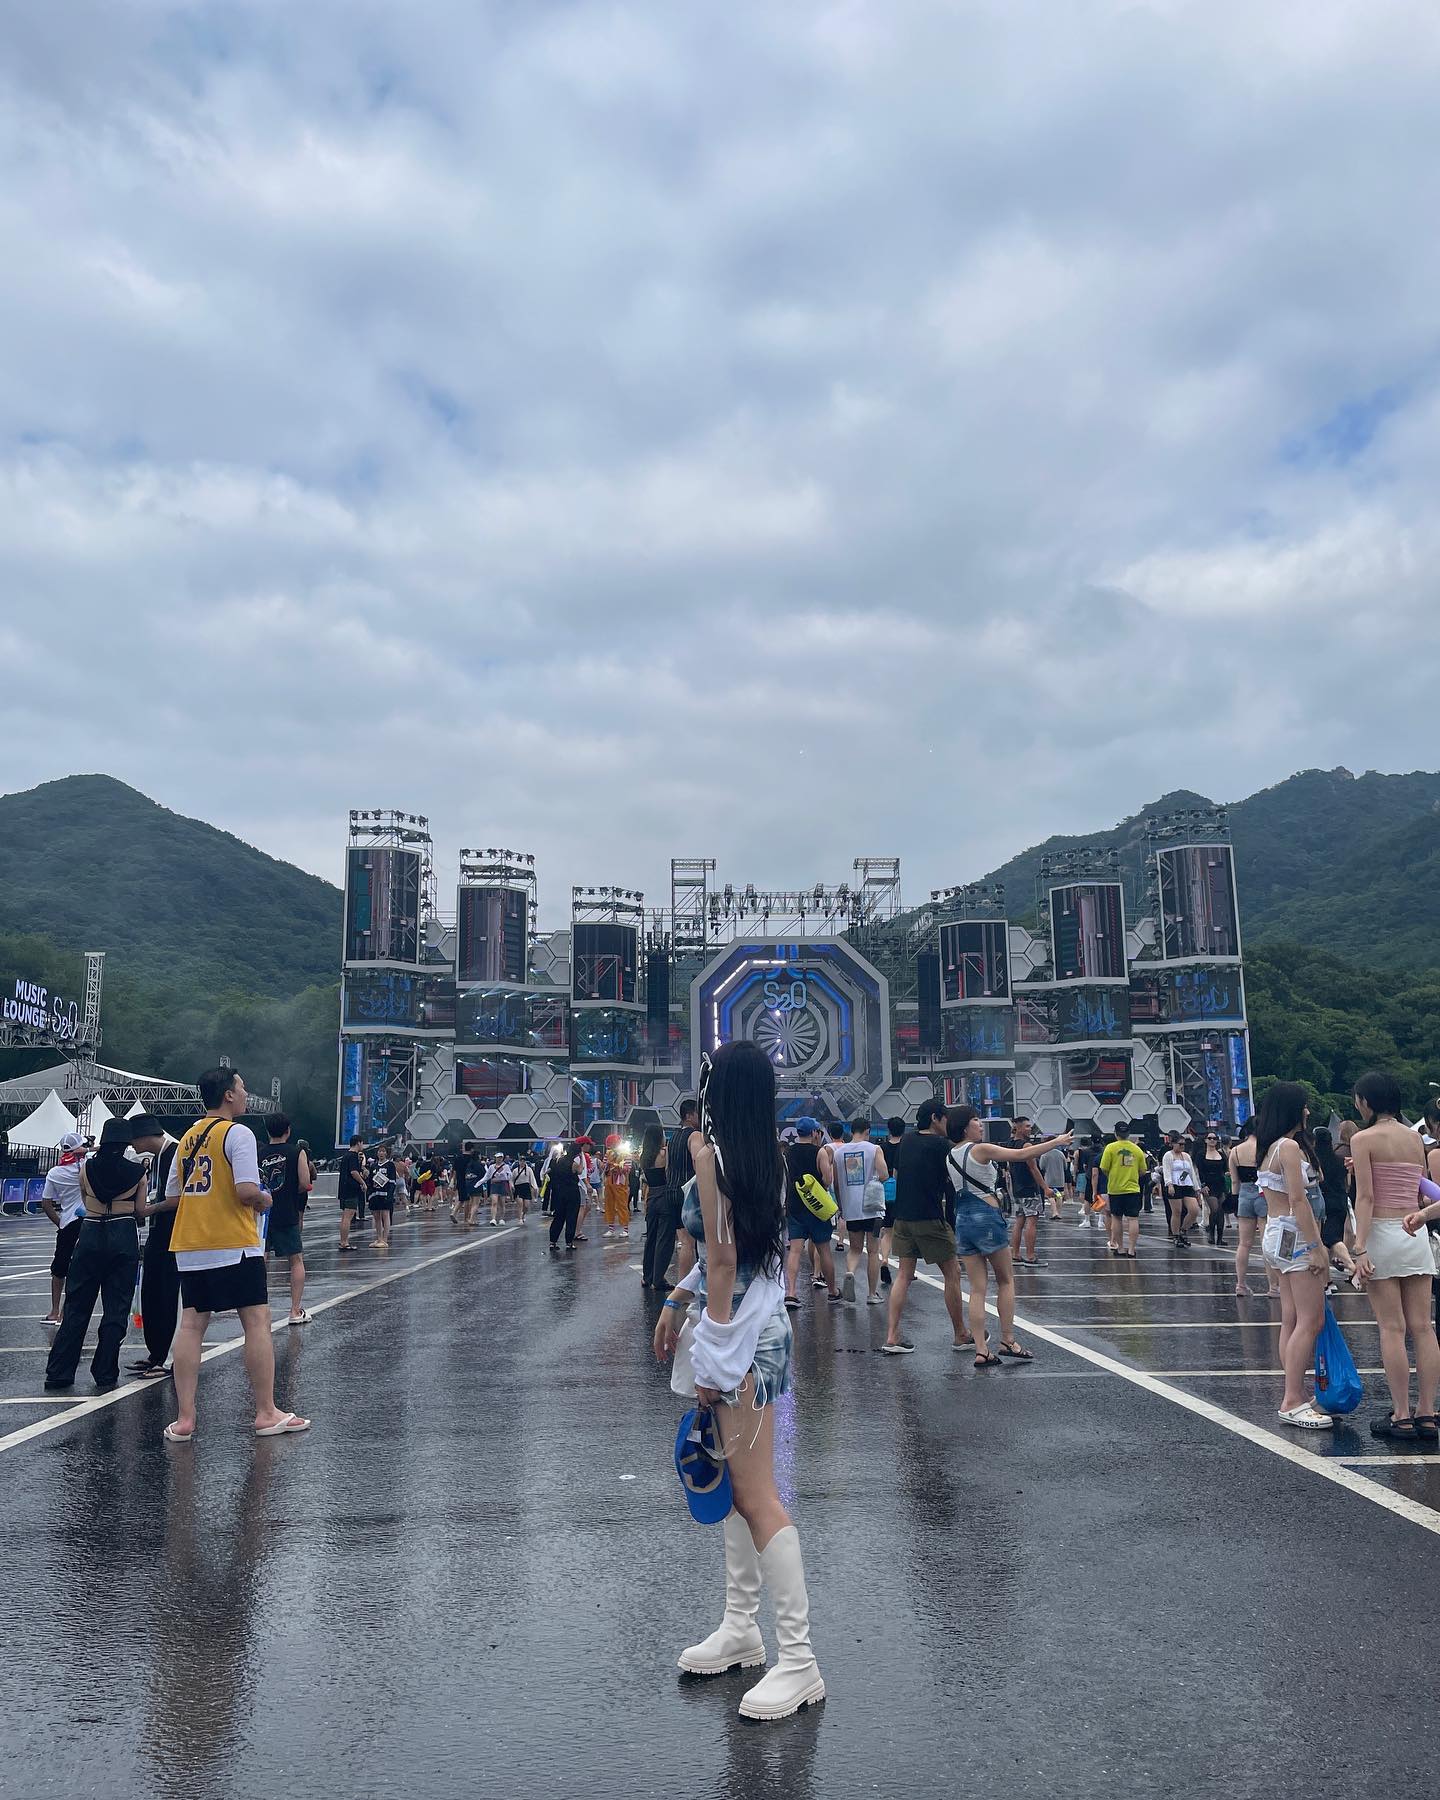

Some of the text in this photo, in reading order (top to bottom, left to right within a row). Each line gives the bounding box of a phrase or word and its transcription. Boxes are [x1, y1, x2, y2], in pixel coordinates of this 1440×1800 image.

[15, 978, 48, 1008] MUSIC
[3, 997, 46, 1028] LOUNGE
[181, 1155, 213, 1196] 23
